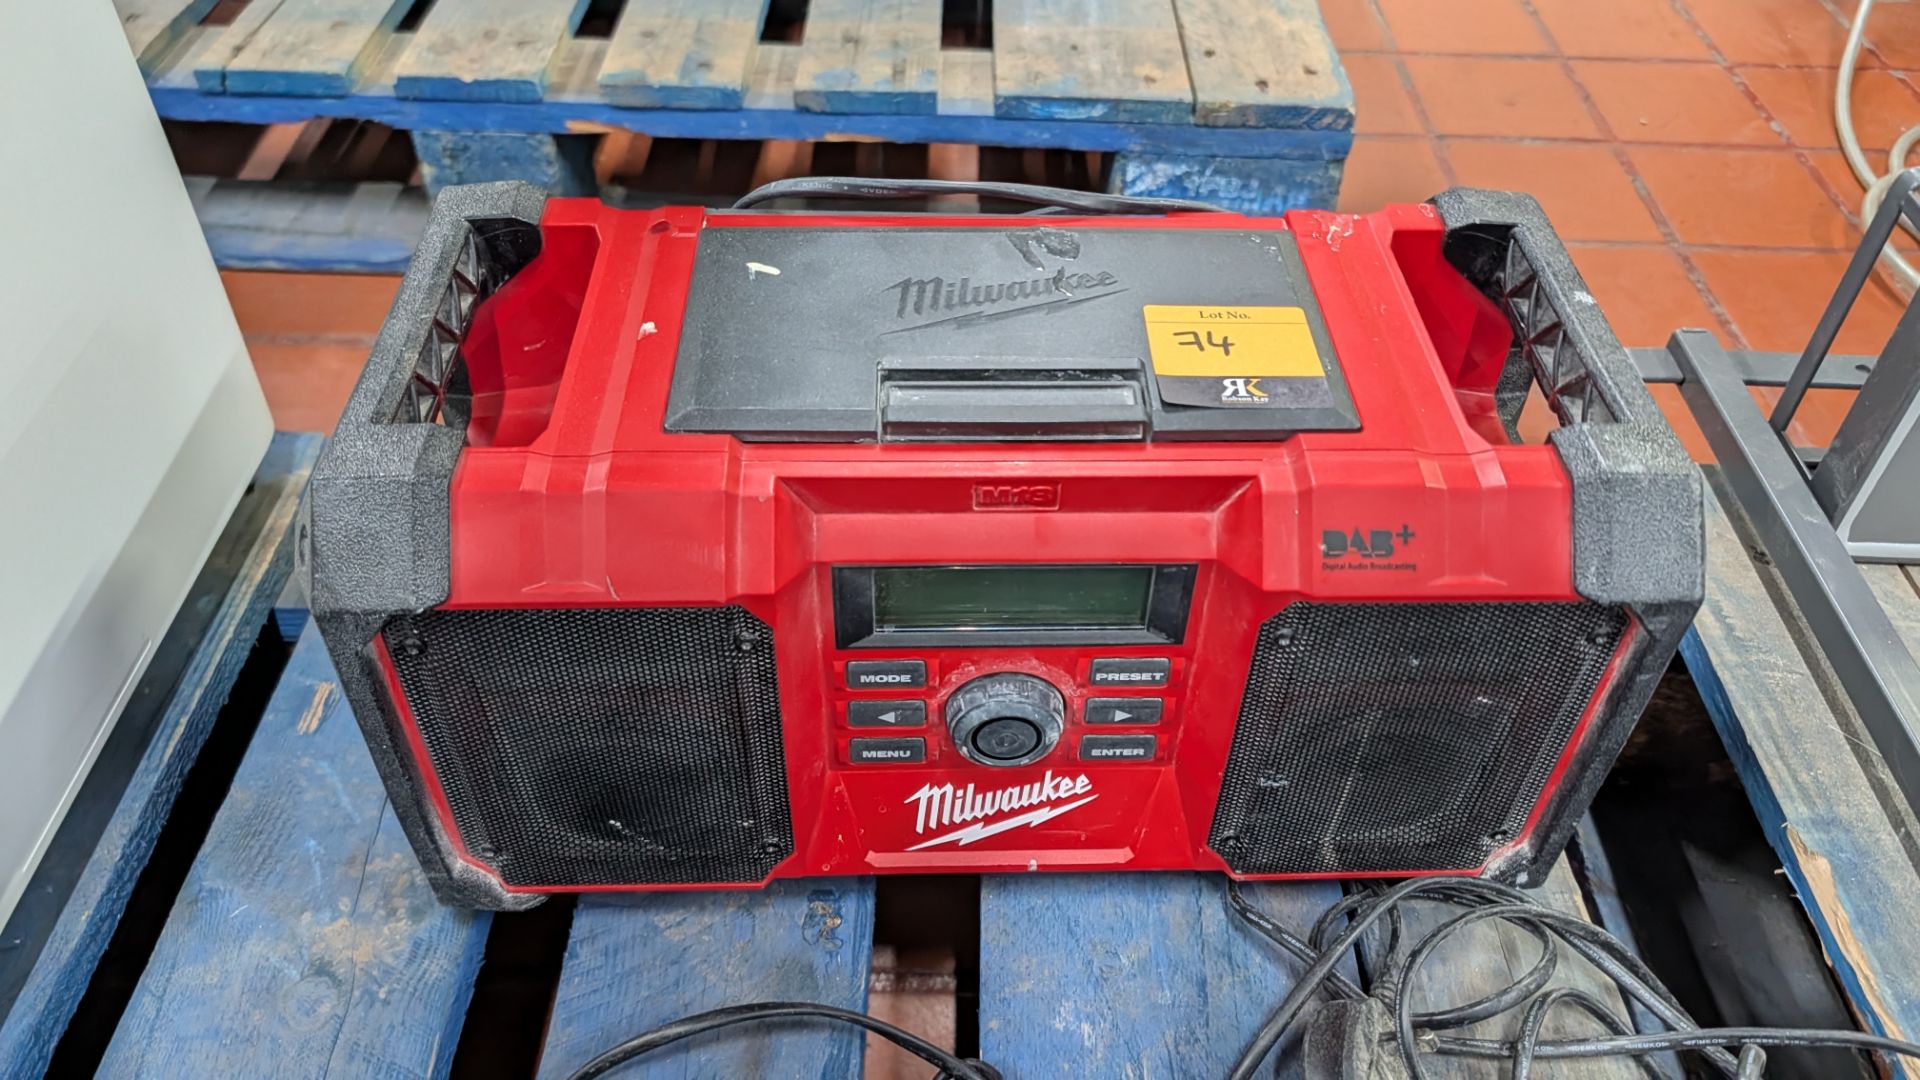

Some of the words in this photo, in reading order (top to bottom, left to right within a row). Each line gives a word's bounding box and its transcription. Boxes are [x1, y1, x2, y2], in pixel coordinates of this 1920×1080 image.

[881, 267, 1119, 318] Milwaukee
[1200, 311, 1223, 319] Lot
[1227, 311, 1251, 319] No.
[1173, 330, 1235, 356] 74
[1322, 523, 1416, 558] DAB+
[1322, 562, 1345, 572] Digital
[1347, 562, 1368, 570] Audio
[1369, 562, 1417, 572] Broadcasting
[860, 674, 912, 683] MODE
[1095, 672, 1165, 682] PRESET
[862, 750, 911, 758] MENU
[1091, 748, 1145, 757] ENTER
[904, 770, 1093, 834] Milwaukee
